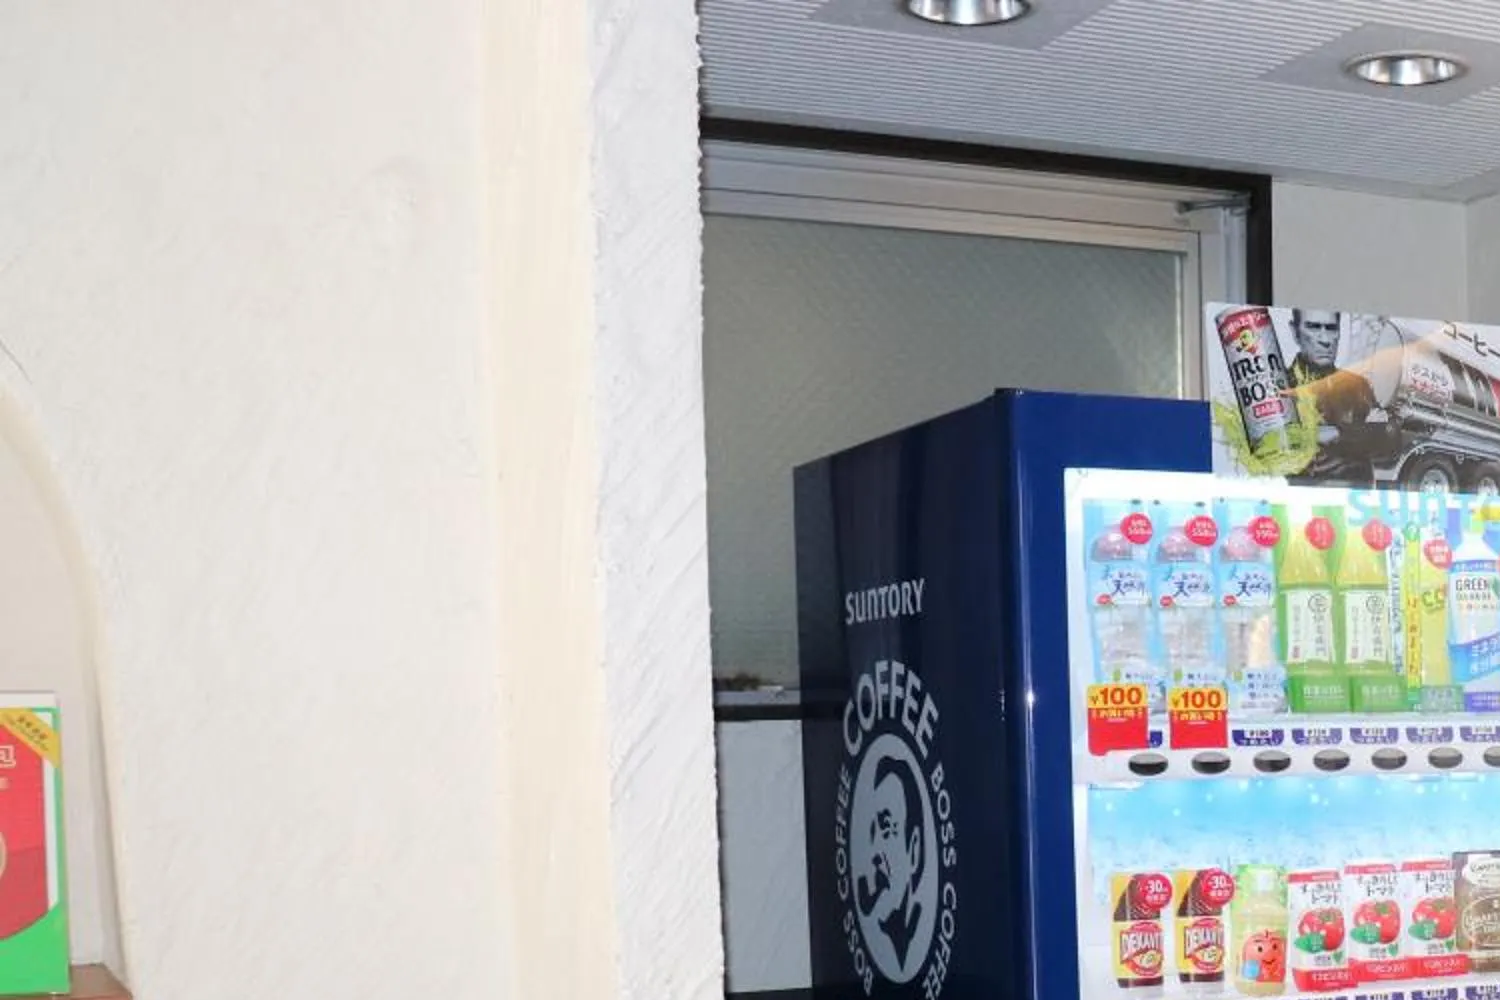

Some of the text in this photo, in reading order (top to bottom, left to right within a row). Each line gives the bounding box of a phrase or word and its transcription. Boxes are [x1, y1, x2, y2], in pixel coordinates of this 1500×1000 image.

[1090, 686, 1143, 706] ¥100
[1171, 689, 1223, 709] ¥100
[843, 659, 939, 760] COFFEE
